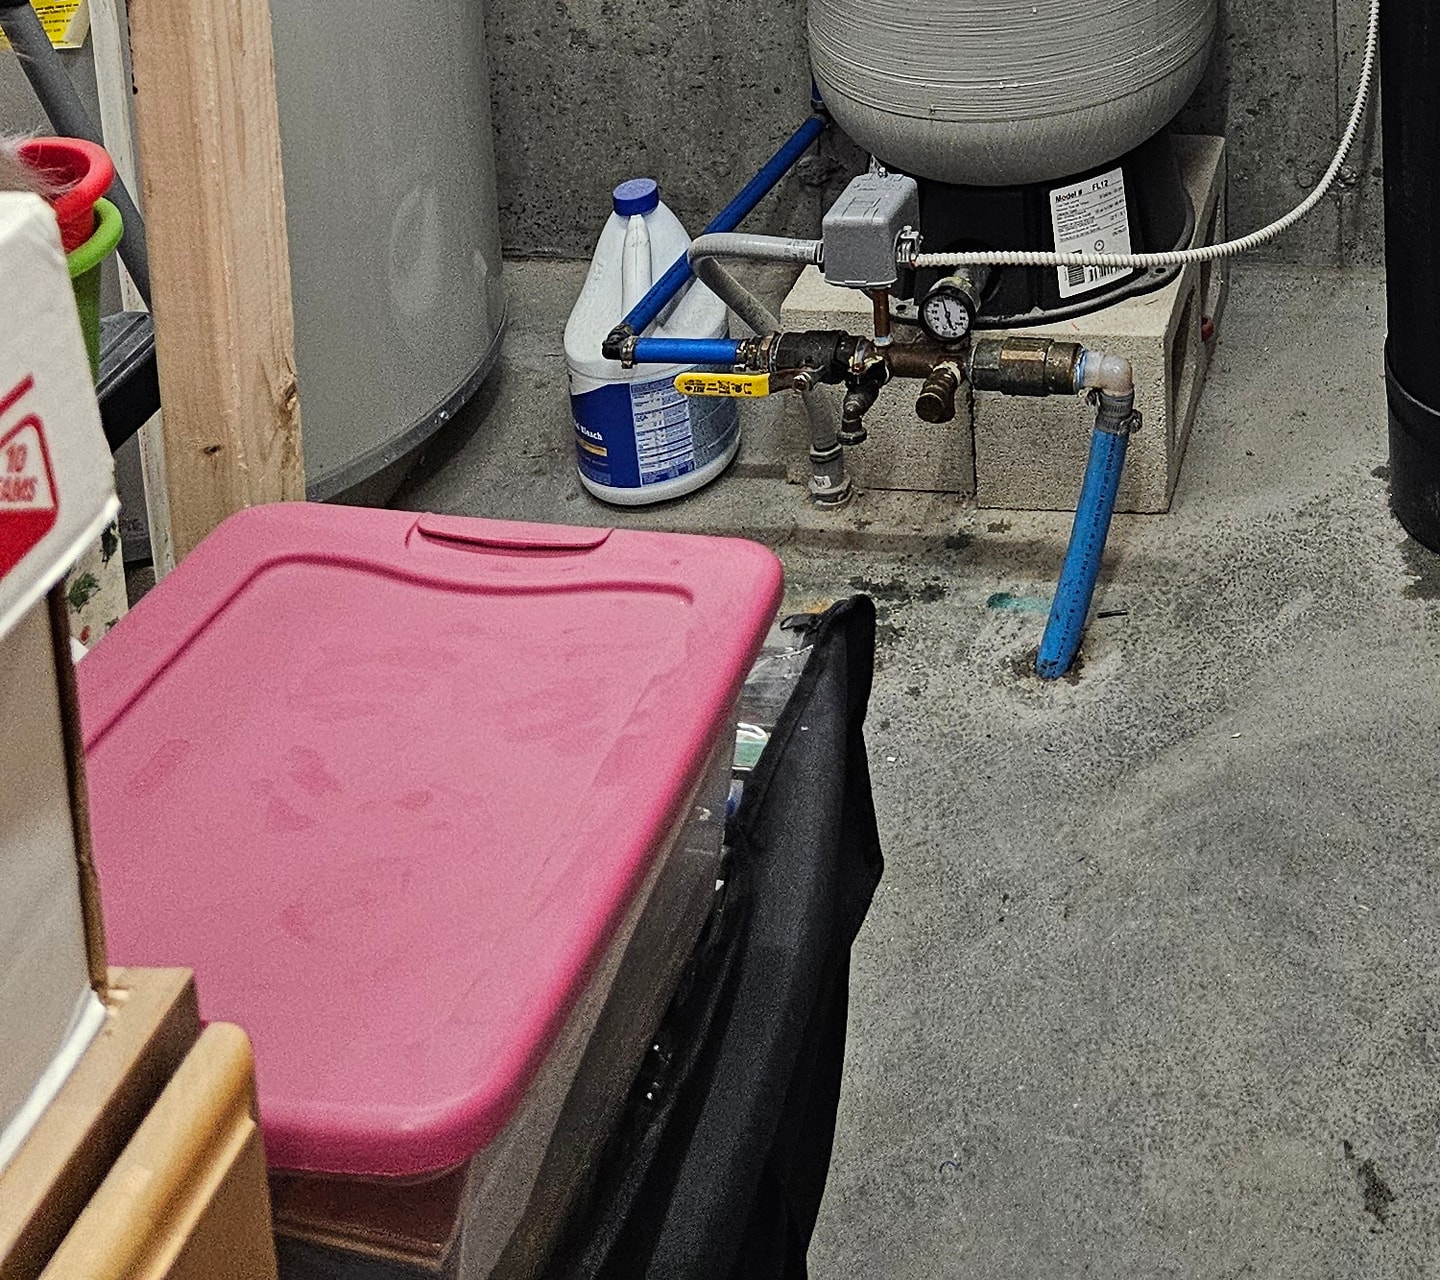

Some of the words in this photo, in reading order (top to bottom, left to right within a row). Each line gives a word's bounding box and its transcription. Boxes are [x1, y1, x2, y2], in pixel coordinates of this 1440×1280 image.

[1056, 190, 1076, 203] Model
[1092, 180, 1109, 191] FL12
[6, 443, 28, 473] 10
